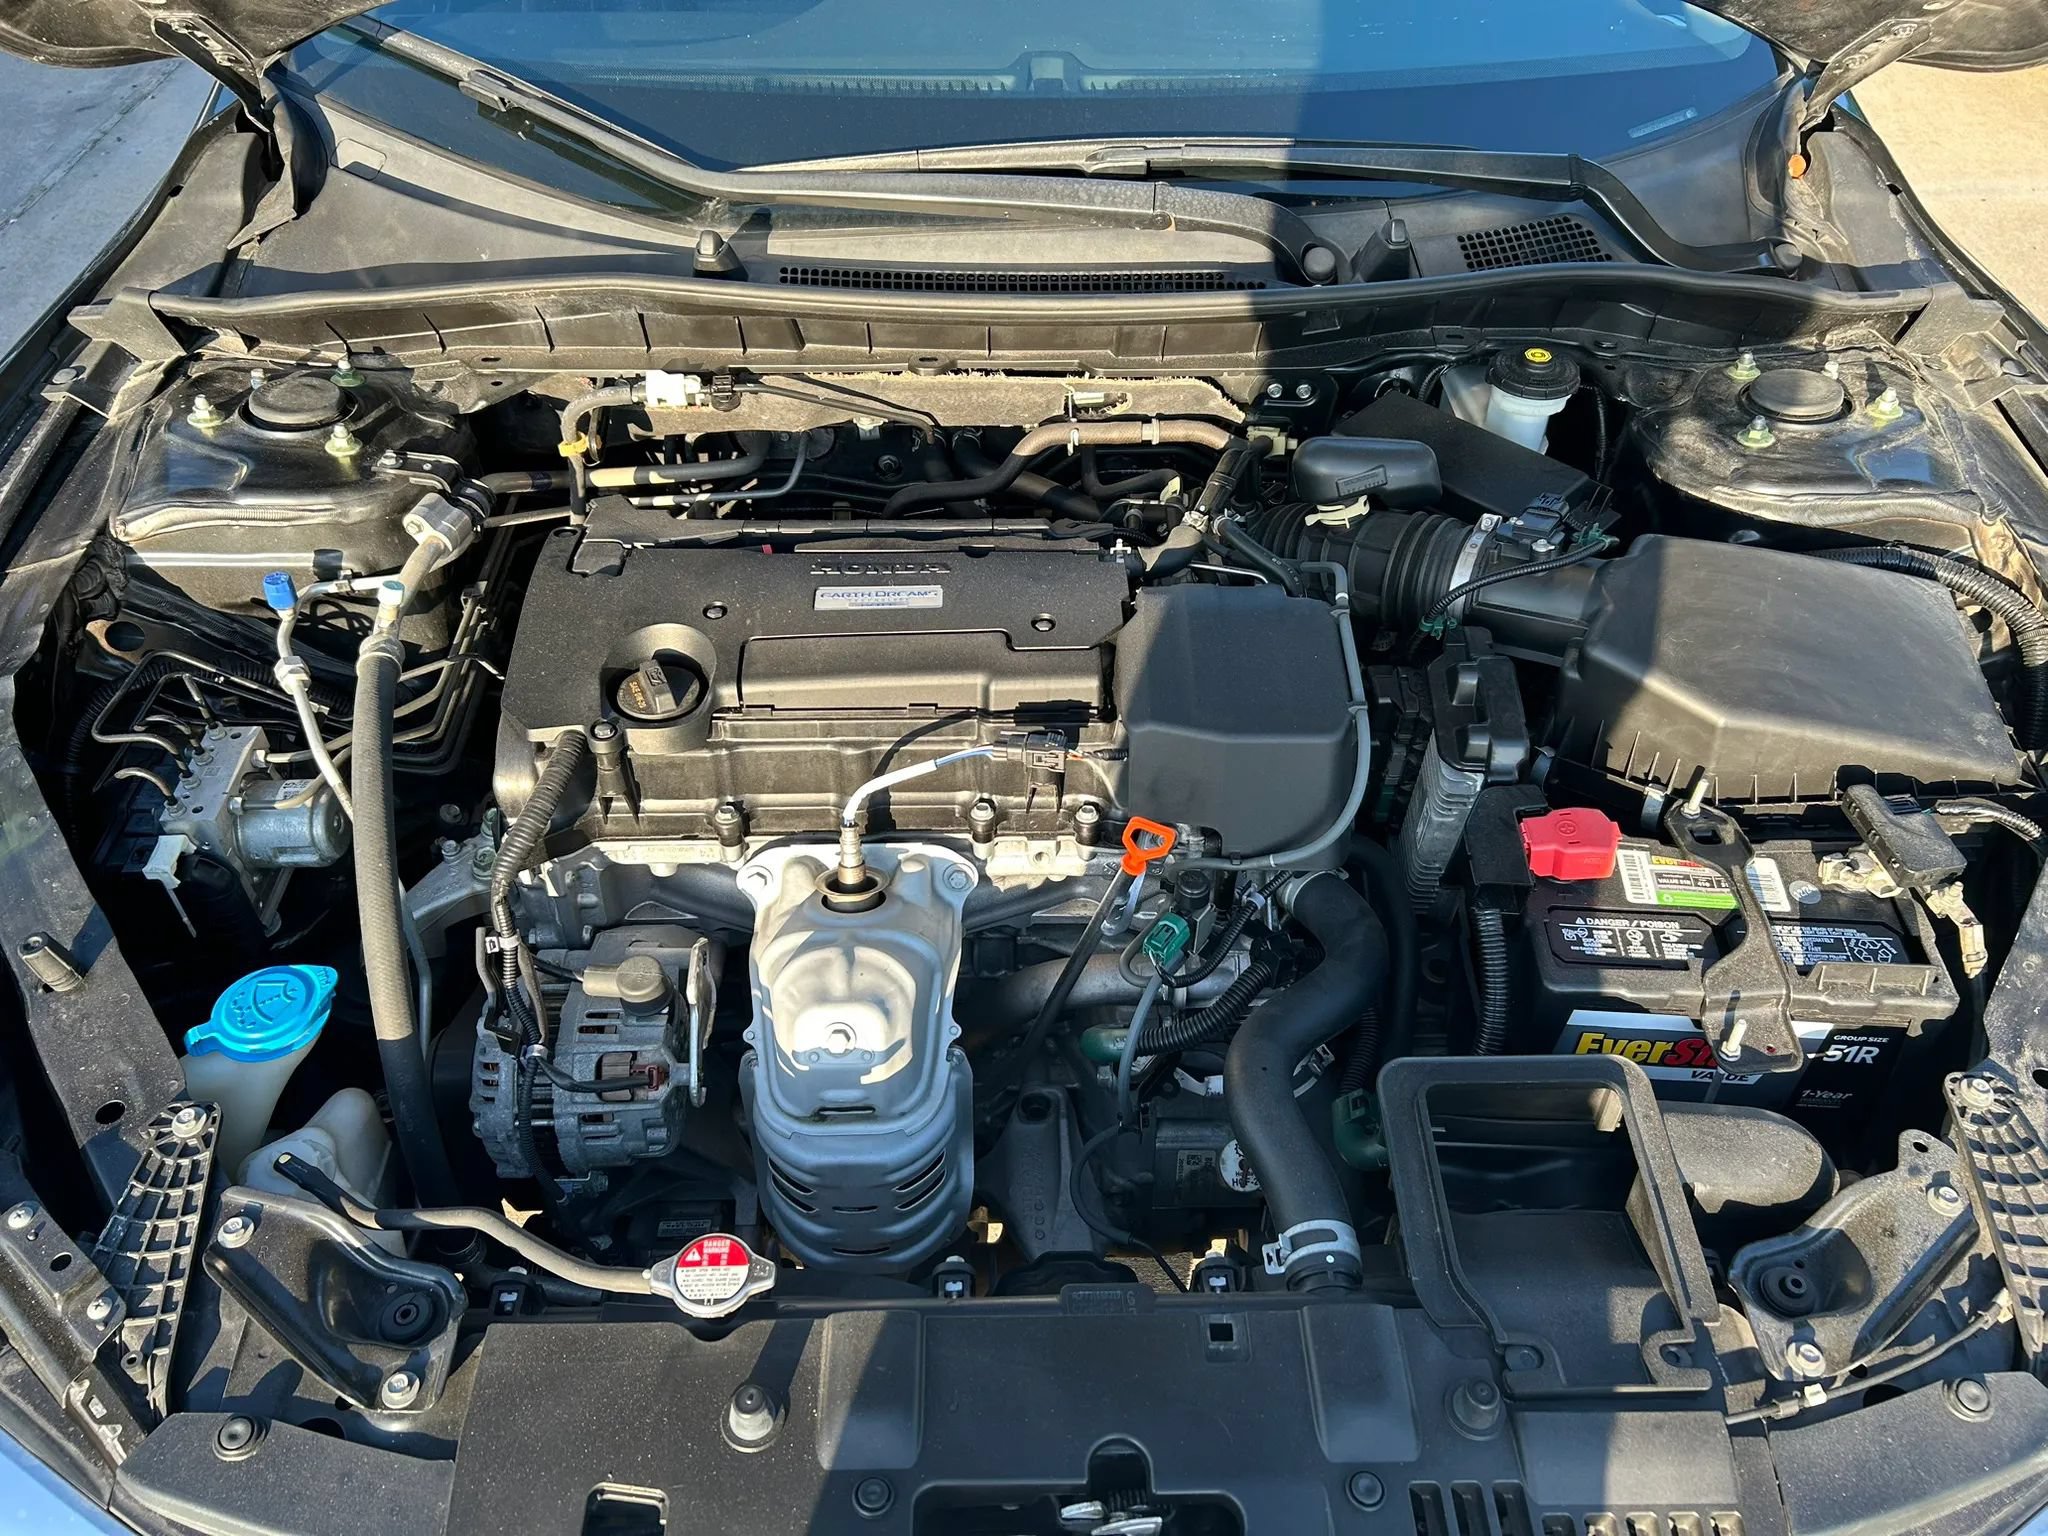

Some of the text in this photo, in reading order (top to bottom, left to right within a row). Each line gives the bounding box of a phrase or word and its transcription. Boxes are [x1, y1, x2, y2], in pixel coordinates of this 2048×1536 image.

[809, 561, 951, 575] HONDA
[1586, 917, 1630, 927] DANGER
[1640, 920, 1680, 930] POISON
[1833, 1034, 1868, 1042] GROUP
[1576, 1032, 1718, 1067] EverSt
[1822, 1044, 1880, 1064] 51R
[1691, 1070, 1750, 1082] VAUE
[1802, 1089, 1853, 1099] 1-Year
